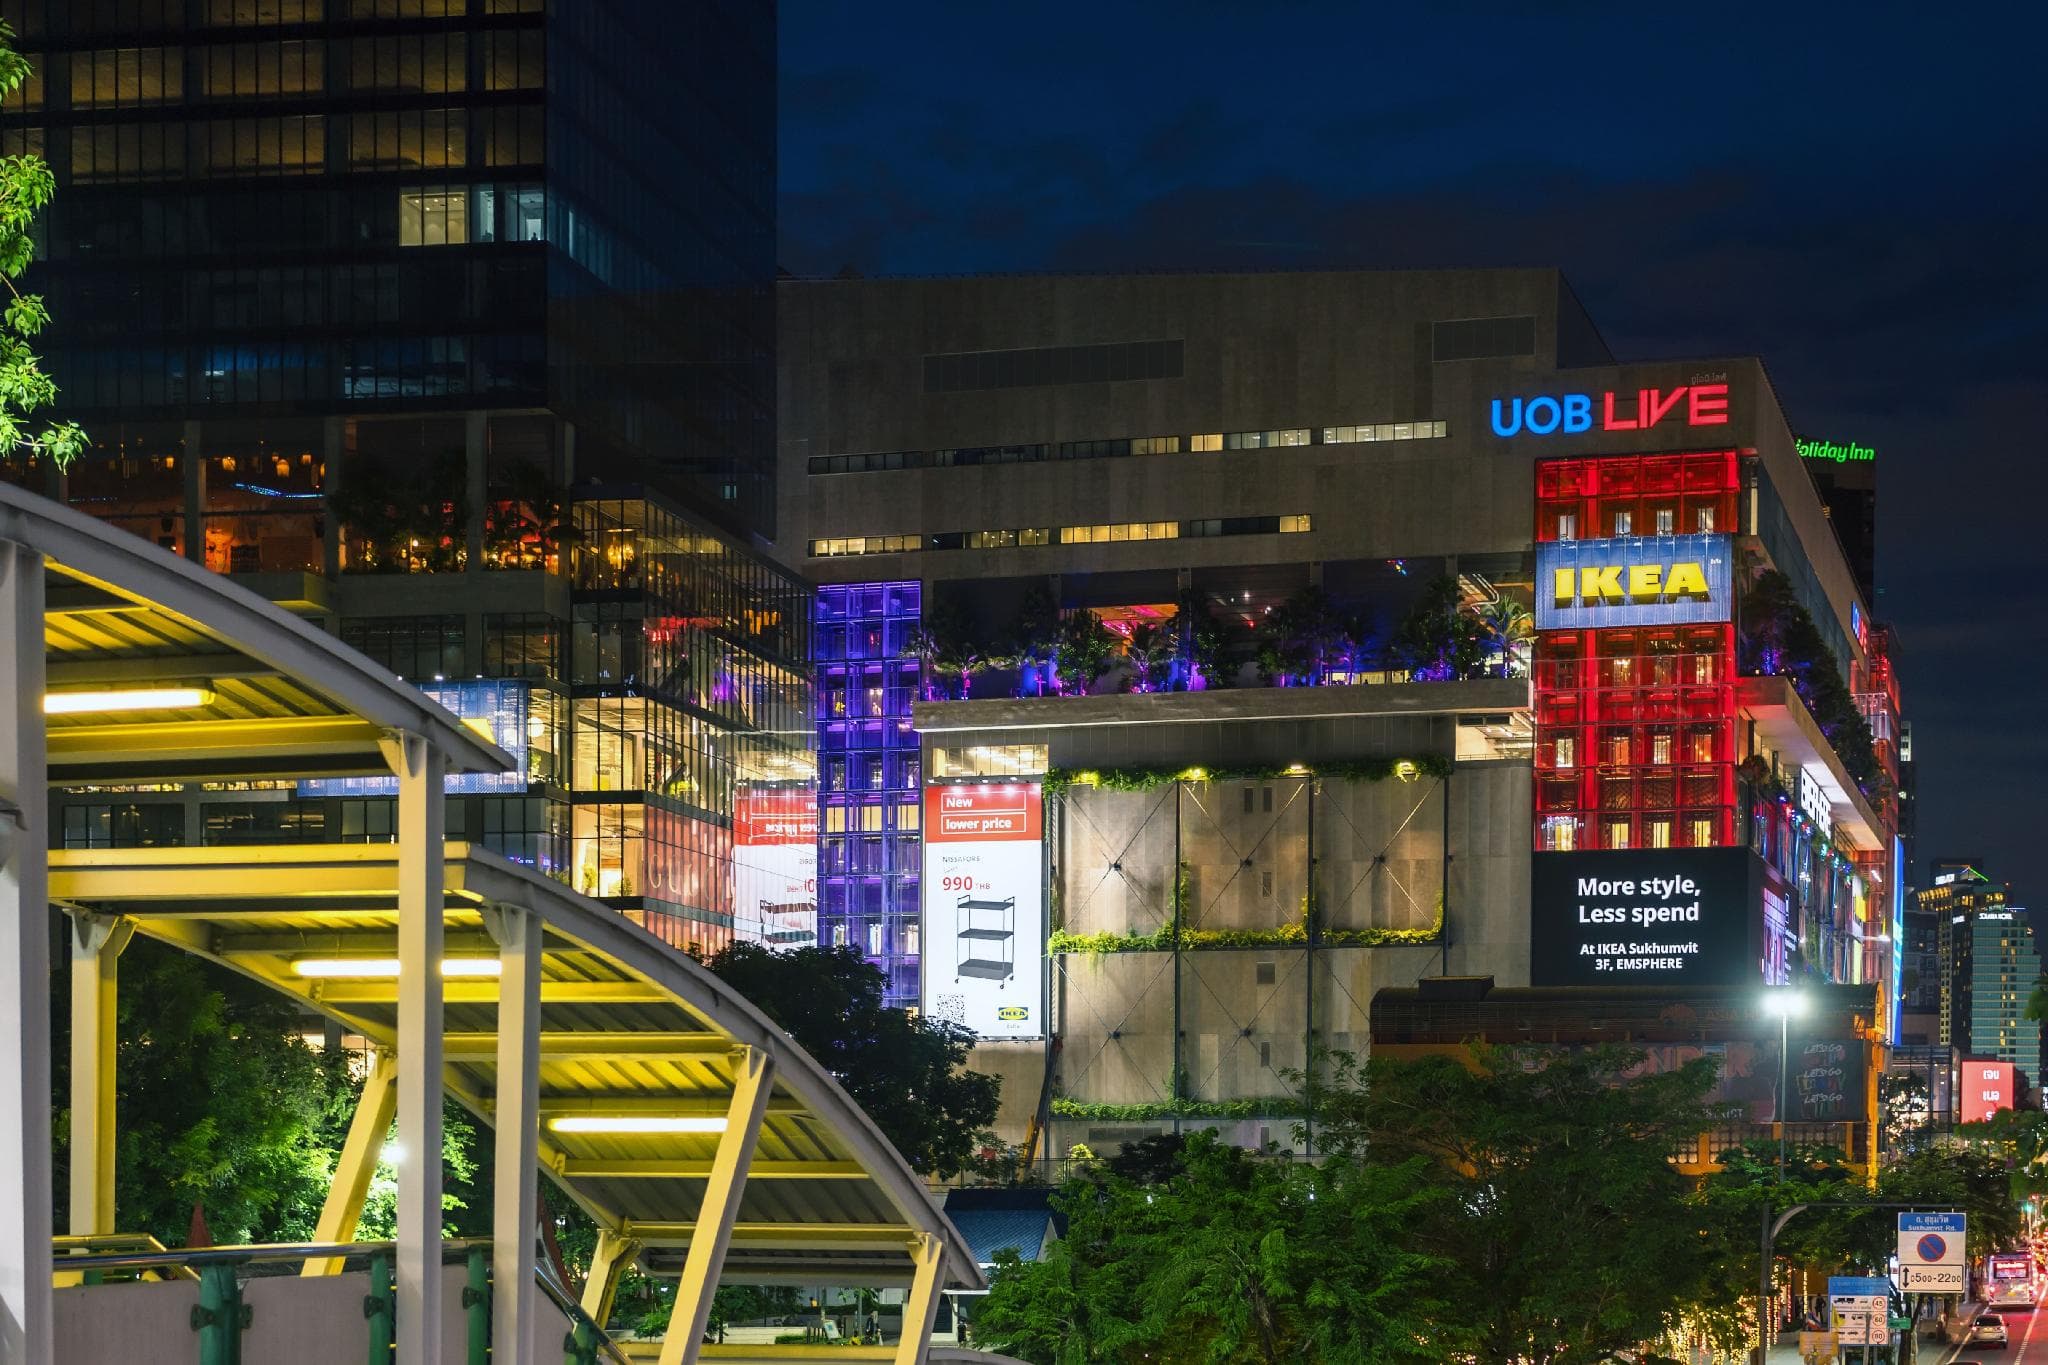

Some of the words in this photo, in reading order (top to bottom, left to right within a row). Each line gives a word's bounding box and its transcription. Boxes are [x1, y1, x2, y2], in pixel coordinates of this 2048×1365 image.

[1491, 394, 1593, 437] UOB
[1604, 384, 1728, 431] LIVE
[1849, 441, 1875, 460] Inn
[1555, 562, 1710, 601] IKEA
[946, 797, 974, 808] New
[945, 818, 980, 830] lower
[981, 817, 1013, 833] price
[942, 876, 973, 891] 990
[1578, 877, 1636, 896] More
[1640, 874, 1701, 900] style,
[1579, 905, 1626, 923] Less
[1631, 901, 1699, 928] spend
[1580, 943, 1596, 955] At
[1597, 943, 1627, 955] IKEA
[1628, 942, 1699, 954] Sukhumvit
[1595, 959, 1614, 971] 3F,
[1616, 958, 1683, 970] EMSPHERE
